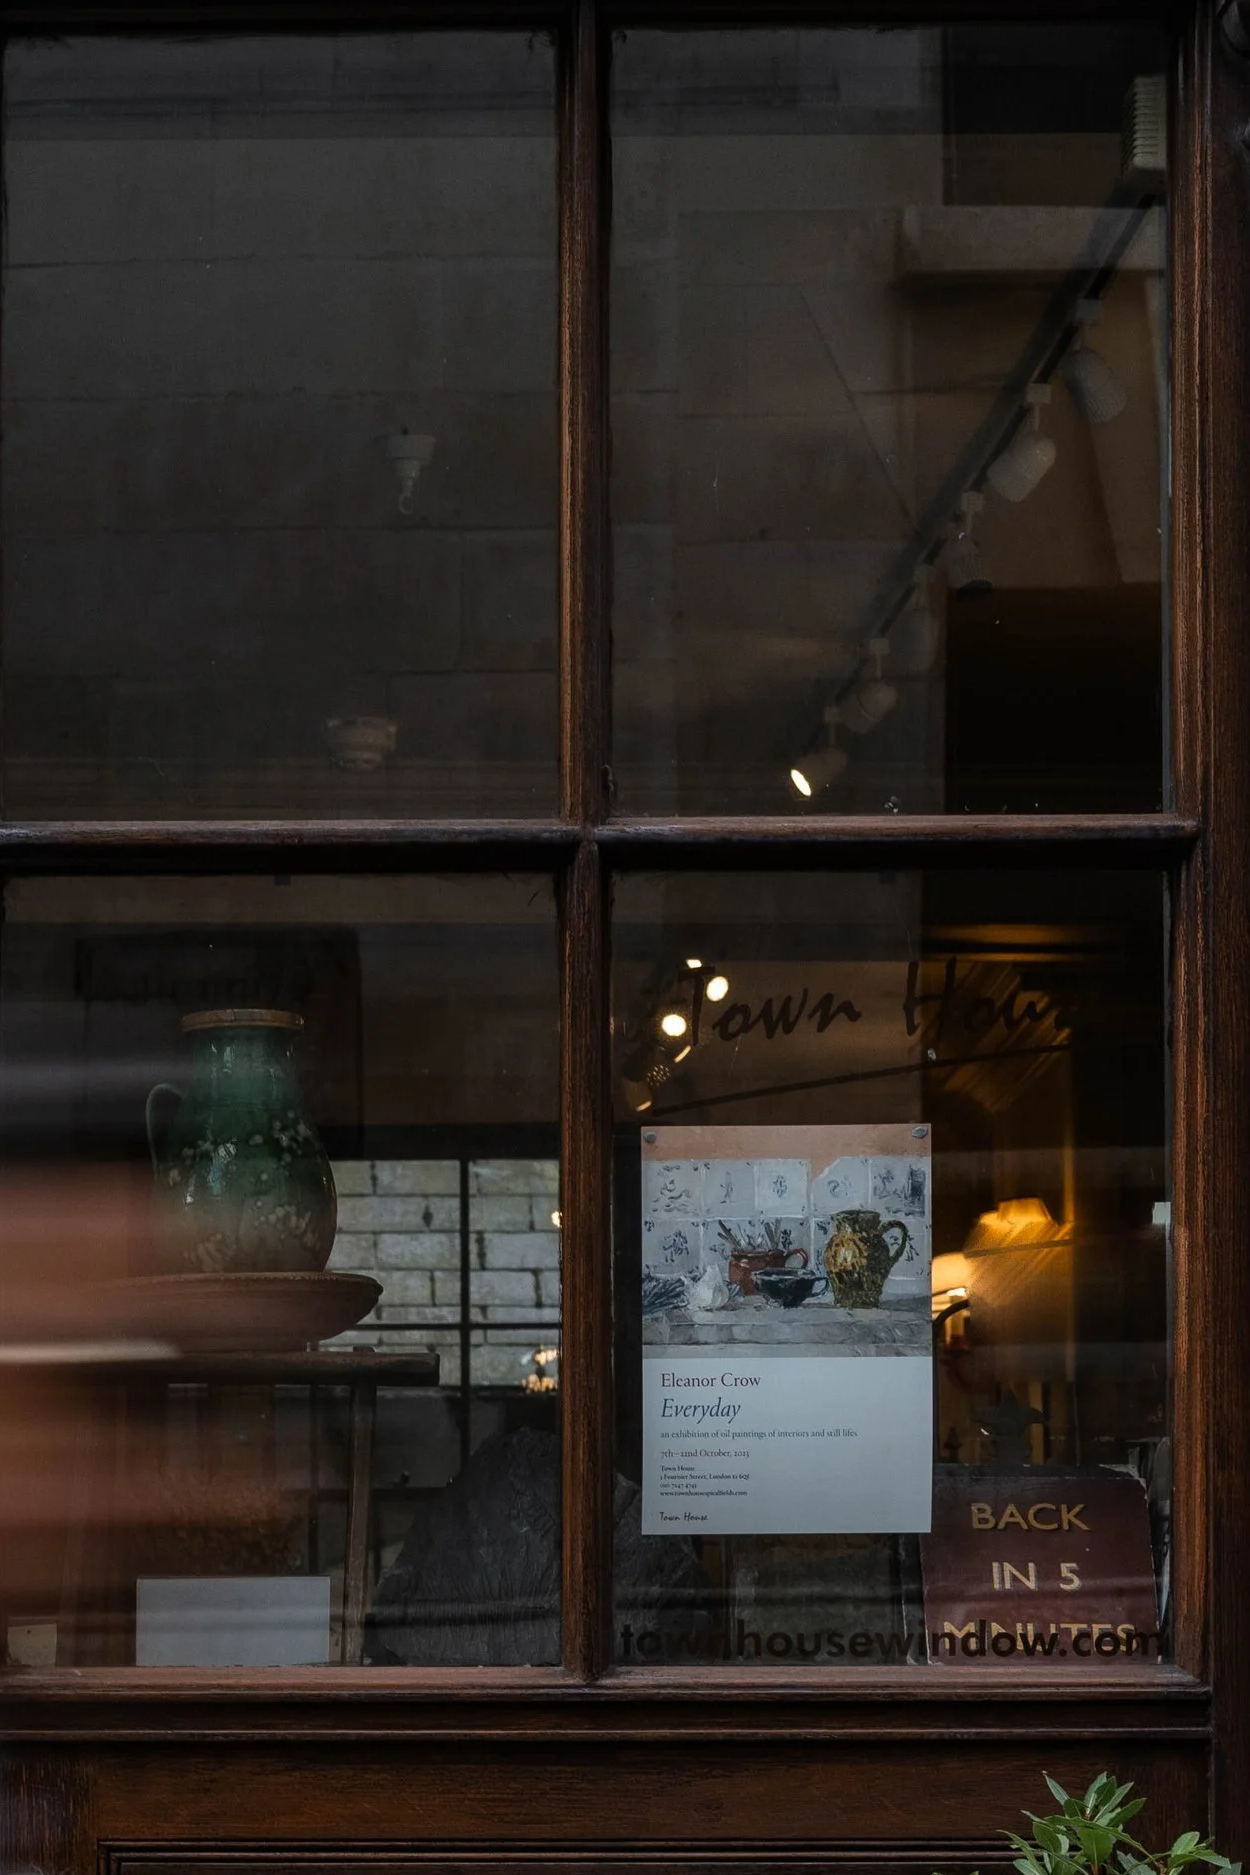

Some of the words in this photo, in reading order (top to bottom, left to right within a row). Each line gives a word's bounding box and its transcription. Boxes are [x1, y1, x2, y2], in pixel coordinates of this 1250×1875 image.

[678, 964, 862, 1046] Town
[902, 955, 1080, 1038] Hou
[661, 1372, 716, 1388] Eleanor
[720, 1372, 761, 1388] Crow
[661, 1397, 742, 1424] Everyday
[671, 1429, 710, 1439] exhibition
[721, 1429, 730, 1438] oil
[732, 1429, 768, 1441] paintings
[777, 1428, 809, 1438] interiors
[811, 1428, 825, 1438] and
[659, 1511, 681, 1522] Town
[683, 1511, 709, 1522] House
[970, 1502, 1092, 1532] BACK
[992, 1561, 1038, 1593] IN
[1059, 1561, 1082, 1592] 5
